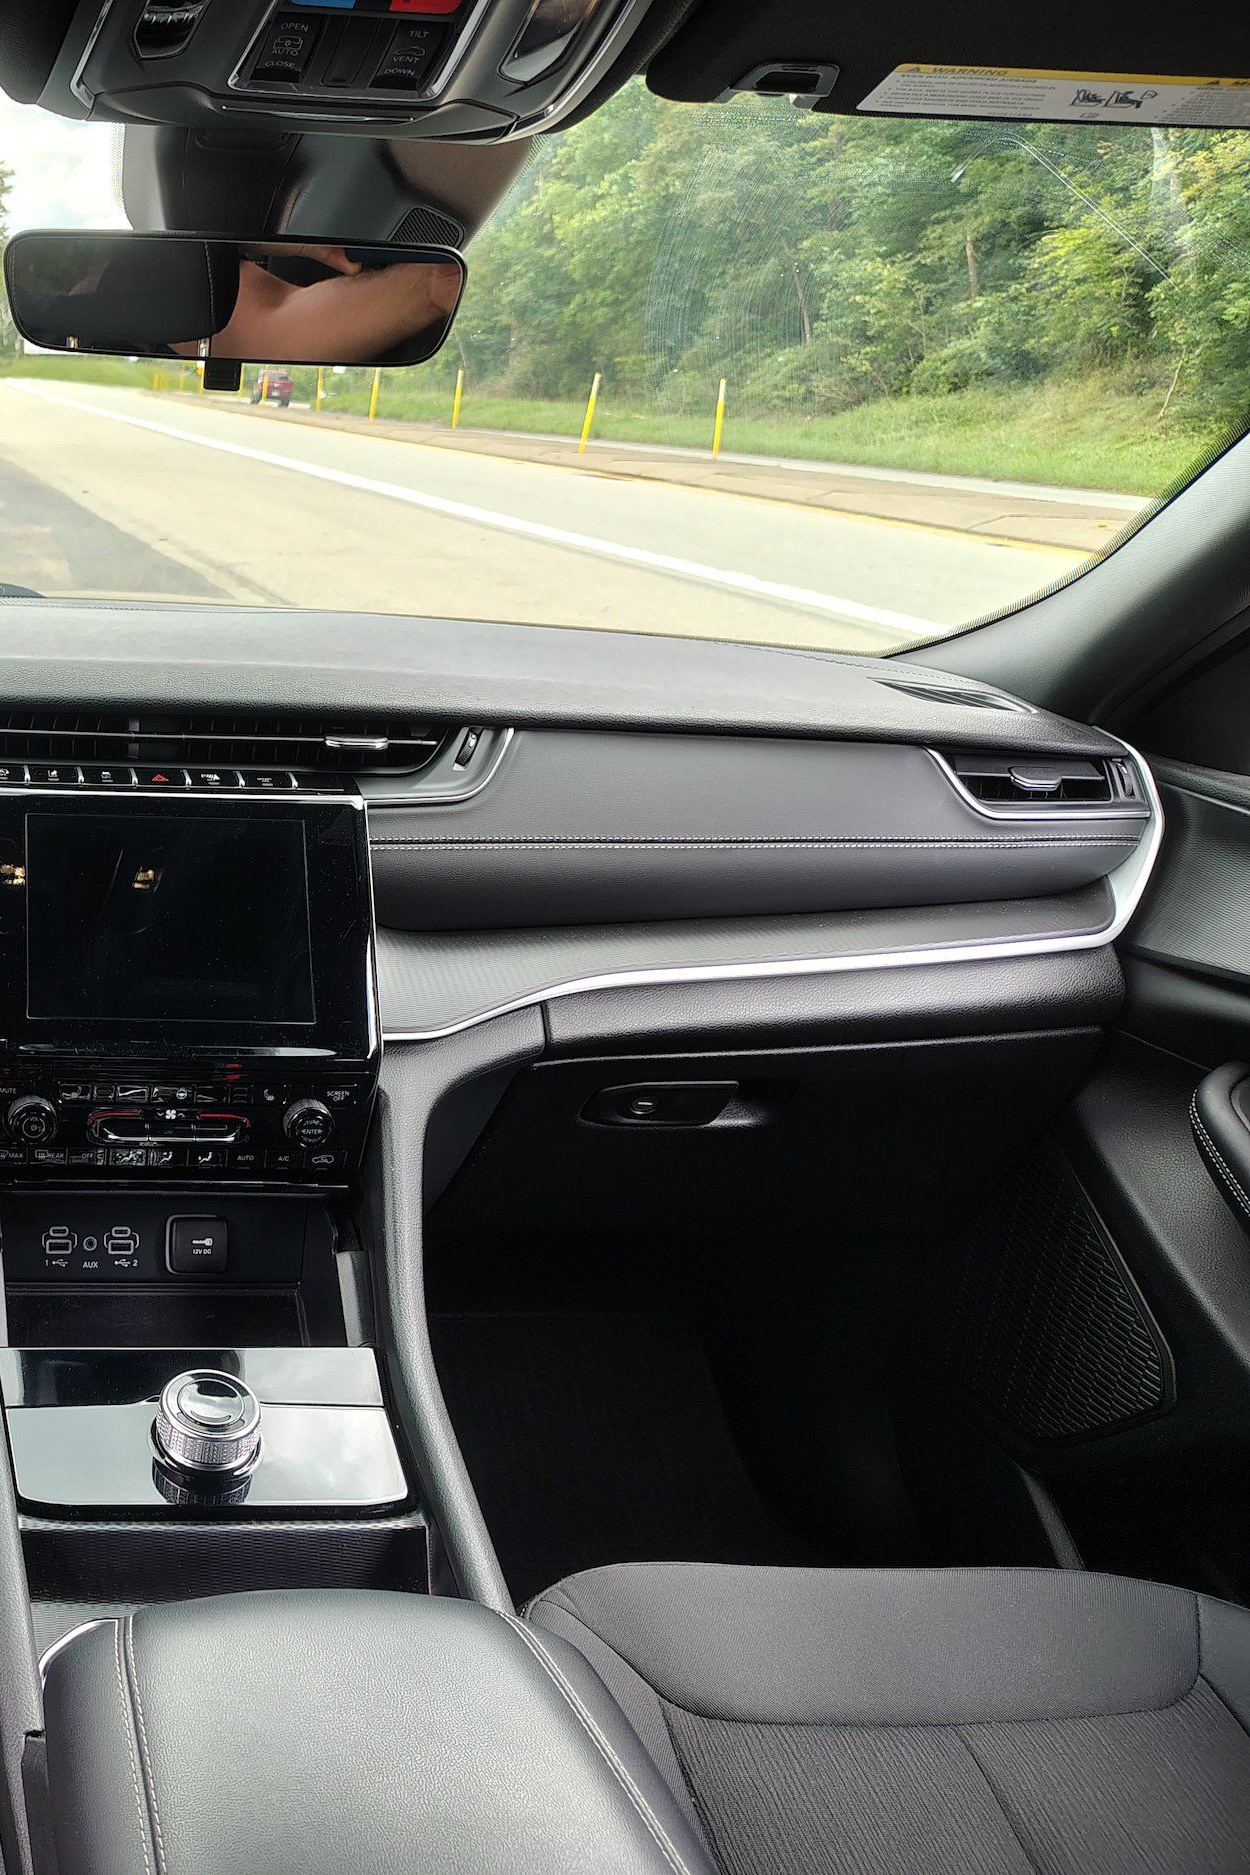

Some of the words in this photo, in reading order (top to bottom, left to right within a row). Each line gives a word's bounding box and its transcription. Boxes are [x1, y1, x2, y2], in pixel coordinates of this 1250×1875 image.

[280, 22, 309, 32] OPEN
[409, 30, 430, 39] TILT
[270, 49, 299, 57] AUTO
[264, 60, 296, 68] CLOSE
[392, 56, 421, 64] VENT
[384, 68, 416, 76] DOWN
[932, 67, 1009, 76] WARNING
[236, 1154, 255, 1162] AUTO
[82, 1261, 98, 1269] AUX
[132, 1259, 138, 1267] 2
